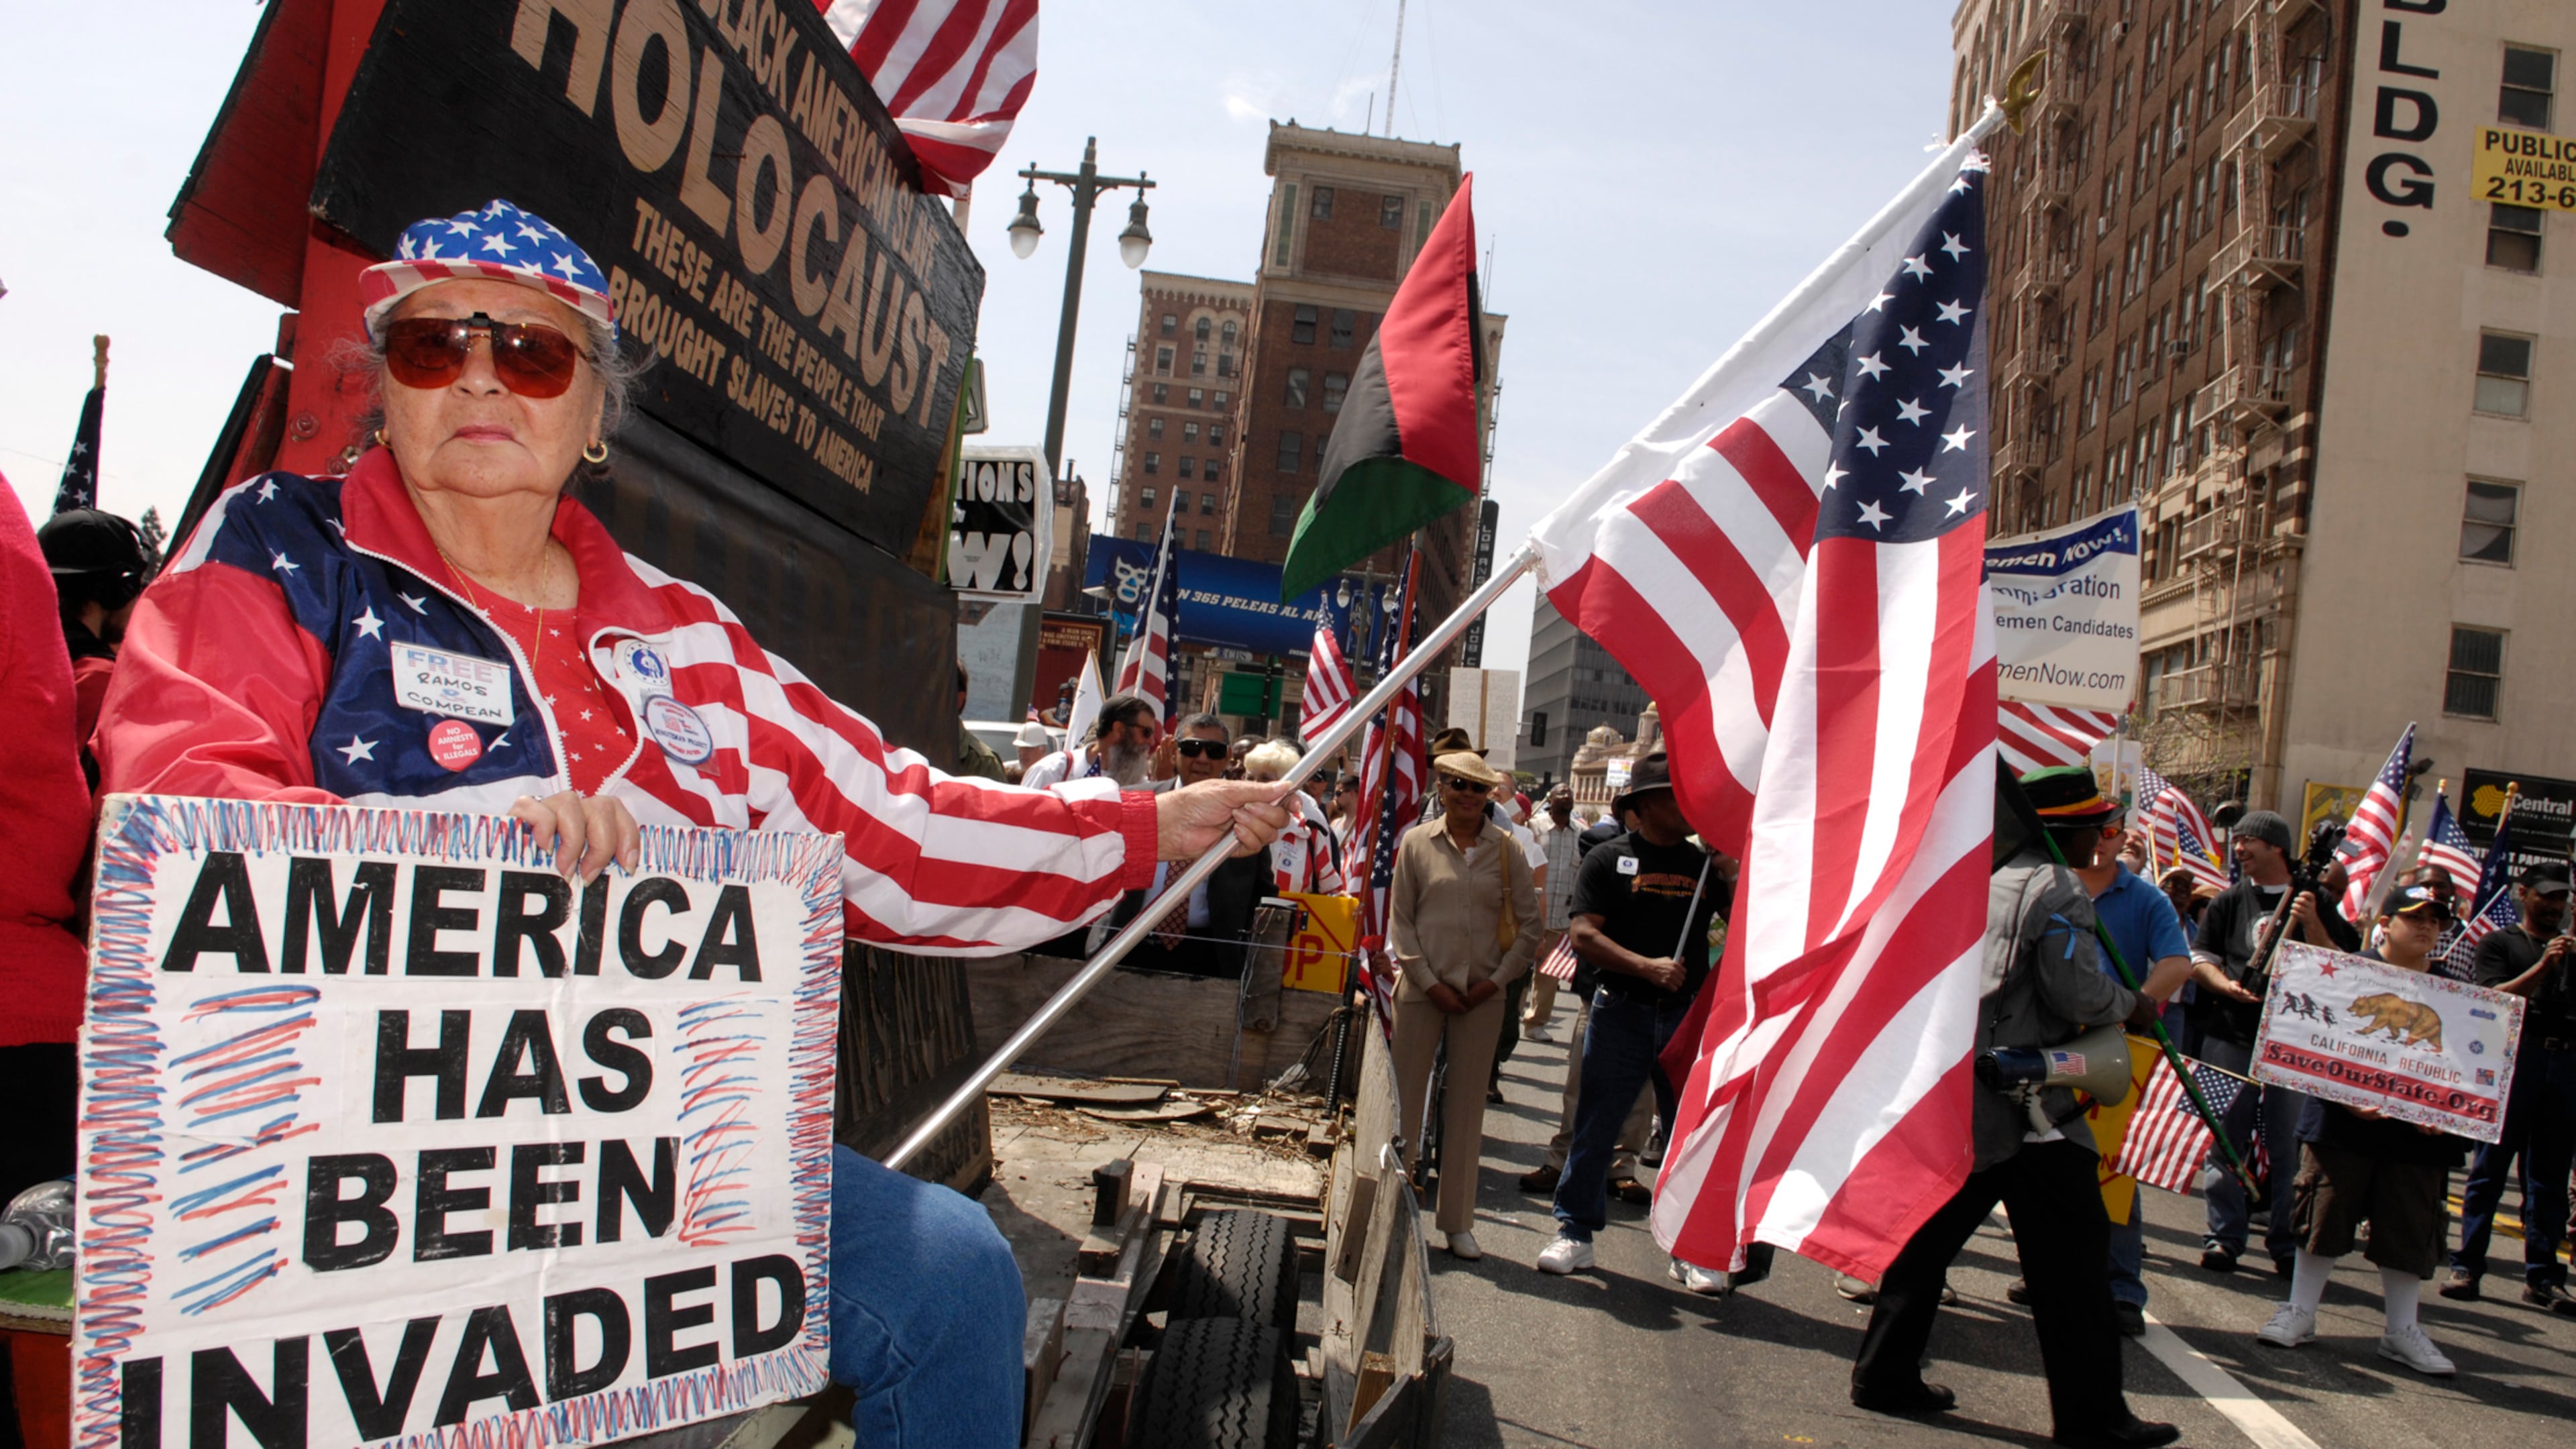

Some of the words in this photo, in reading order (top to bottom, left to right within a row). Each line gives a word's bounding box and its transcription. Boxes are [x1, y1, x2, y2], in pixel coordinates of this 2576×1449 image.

[2365, 0, 2447, 238] LDG.
[790, 50, 898, 233] AMERICAN
[2485, 129, 2576, 162] PUBLIC
[2504, 158, 2576, 182] AVAILABL
[2485, 176, 2576, 209] 213-6
[632, 197, 713, 303] THESE
[708, 271, 759, 339] ARE
[758, 305, 797, 370] THE
[792, 338, 853, 418] PEOPLE
[849, 387, 885, 442] THAT
[609, 265, 727, 388] BROUGHT
[727, 355, 795, 434] SLAVES
[794, 405, 817, 451] TO
[813, 425, 874, 495] AMERICA
[1191, 590, 1220, 605] 365
[1219, 596, 1279, 615] PELEAS
[1280, 605, 1299, 619] AL
[2052, 615, 2134, 639] Candidates
[407, 649, 494, 684] FREE
[417, 672, 488, 696] RAMOS
[407, 691, 502, 718] COMPEAN
[437, 732, 474, 745] AMNESTY
[446, 727, 461, 736] NO
[443, 747, 478, 759] ILLEGALS
[2511, 792, 2574, 816] Central
[160, 851, 763, 983] AMERICA
[372, 1007, 653, 1124] HAS
[2310, 1034, 2388, 1065] CALIFORNIA
[2399, 1057, 2462, 1084] REPUBLIC
[2267, 1044, 2495, 1120] SaveOurState.Org
[302, 1136, 682, 1273] BEEN
[121, 1253, 807, 1449] INVADED
